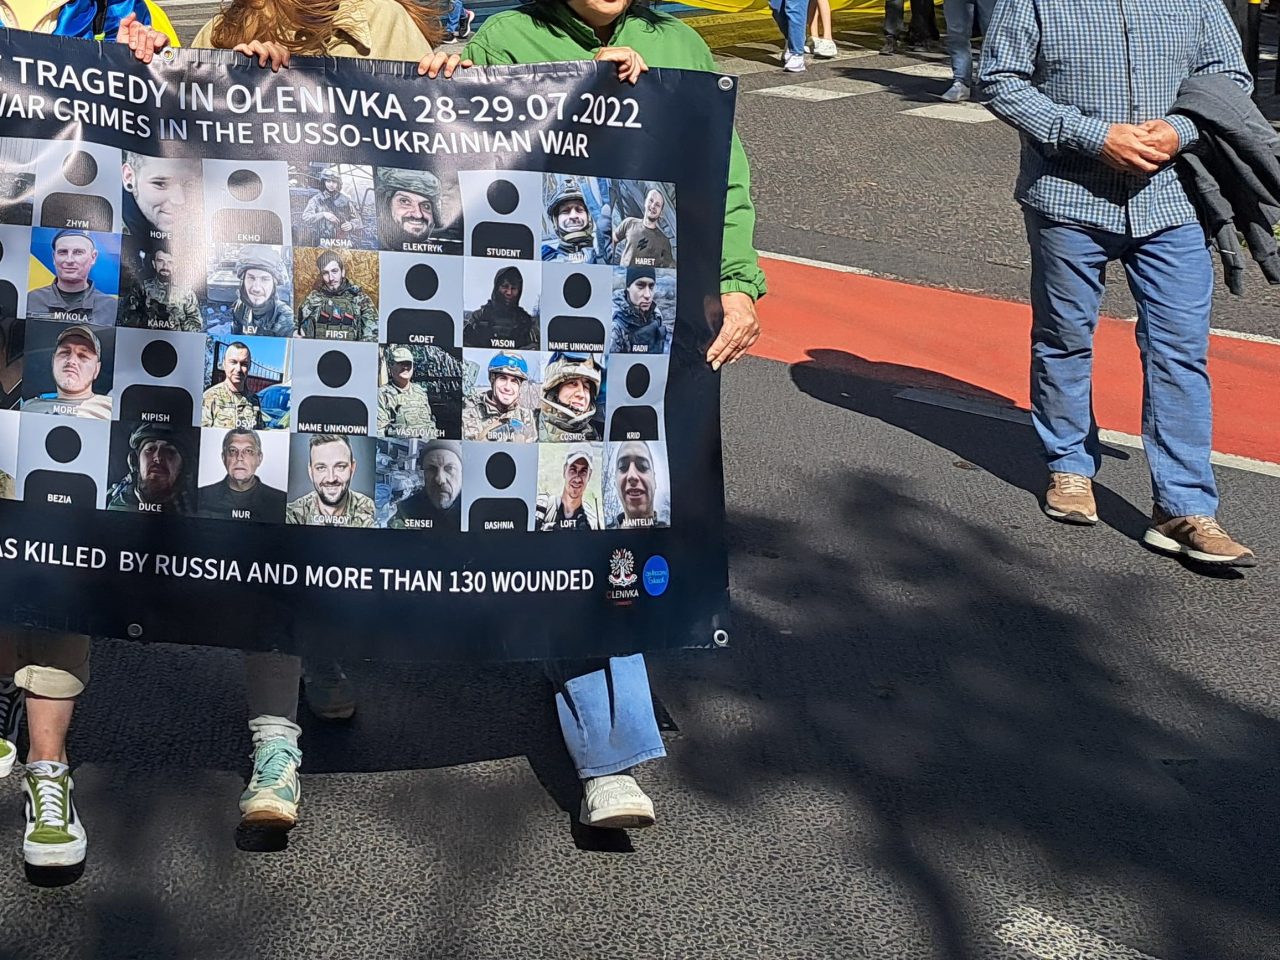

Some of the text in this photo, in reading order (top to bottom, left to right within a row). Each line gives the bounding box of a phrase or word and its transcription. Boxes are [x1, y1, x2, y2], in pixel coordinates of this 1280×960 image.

[13, 55, 169, 109] TRAGEDY
[178, 82, 214, 112] IN
[225, 83, 408, 122] OLENIVKA
[412, 92, 643, 130] 28-29.07.2022
[52, 97, 151, 139] CRIMES
[159, 116, 188, 141] IN
[195, 119, 254, 145] THE
[262, 121, 533, 157] RUSSO-UKRAINIAN
[541, 129, 590, 158] WAR
[65, 219, 90, 229] ZHYM
[150, 230, 173, 240] HOPE
[237, 233, 261, 243] EKHO
[320, 237, 353, 248] PAKSHA
[402, 242, 444, 253] ELEKTRYK
[486, 247, 521, 258] STUDENT
[634, 257, 656, 267] HARET
[54, 311, 89, 322] MYKOLA
[147, 319, 176, 329] KARAS
[242, 325, 259, 335] LEV
[325, 329, 349, 339] FIRST
[409, 334, 435, 344] CADET
[490, 338, 516, 348] YASON
[549, 341, 604, 352] NAME UNKNOWN
[53, 405, 78, 415] MORE
[141, 412, 171, 423] KIPISH
[298, 422, 368, 435] NAME UNKNOWN
[396, 427, 446, 438] VASYLOVYCH
[559, 432, 587, 441] COSMOS
[626, 431, 641, 440] KRID
[47, 493, 73, 504] BEZIA
[138, 502, 163, 512] DUCE
[231, 509, 251, 519] NUR
[312, 514, 350, 525] COWBOY
[404, 518, 433, 529] SENSEI
[560, 519, 577, 528] LOFT
[484, 520, 515, 530] BASHNIA
[23, 540, 107, 571] KILLED
[119, 550, 150, 574] BY
[155, 554, 242, 582] RUSSIA
[246, 560, 299, 586] AND
[304, 564, 373, 590] MORE
[379, 568, 442, 592] THAN
[448, 570, 487, 593] 130
[491, 568, 595, 593] WOUNDED
